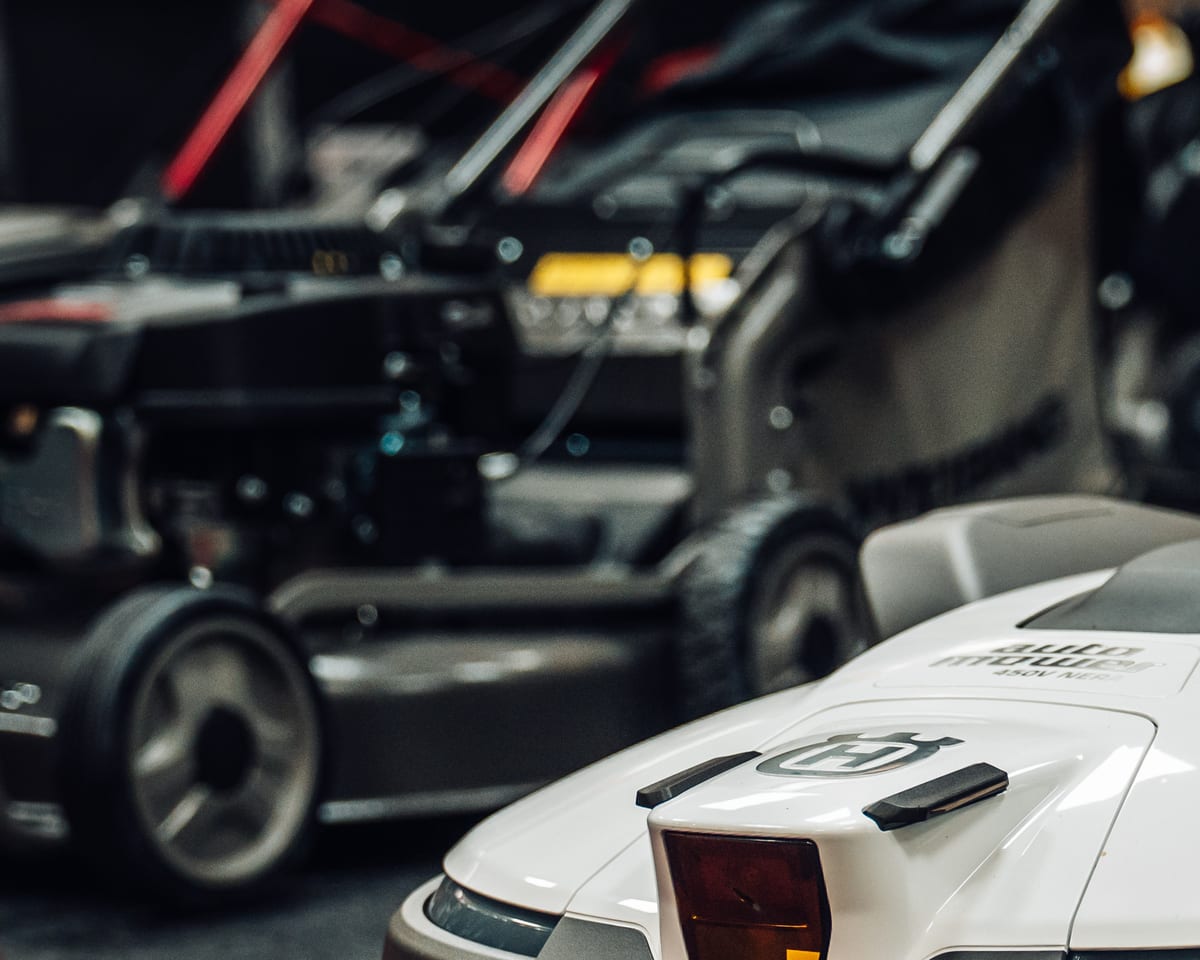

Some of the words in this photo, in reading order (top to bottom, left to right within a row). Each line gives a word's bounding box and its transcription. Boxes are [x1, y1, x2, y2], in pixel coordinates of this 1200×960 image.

[990, 643, 1145, 656] auto
[928, 655, 1167, 672] mower
[992, 669, 1057, 678] 450V
